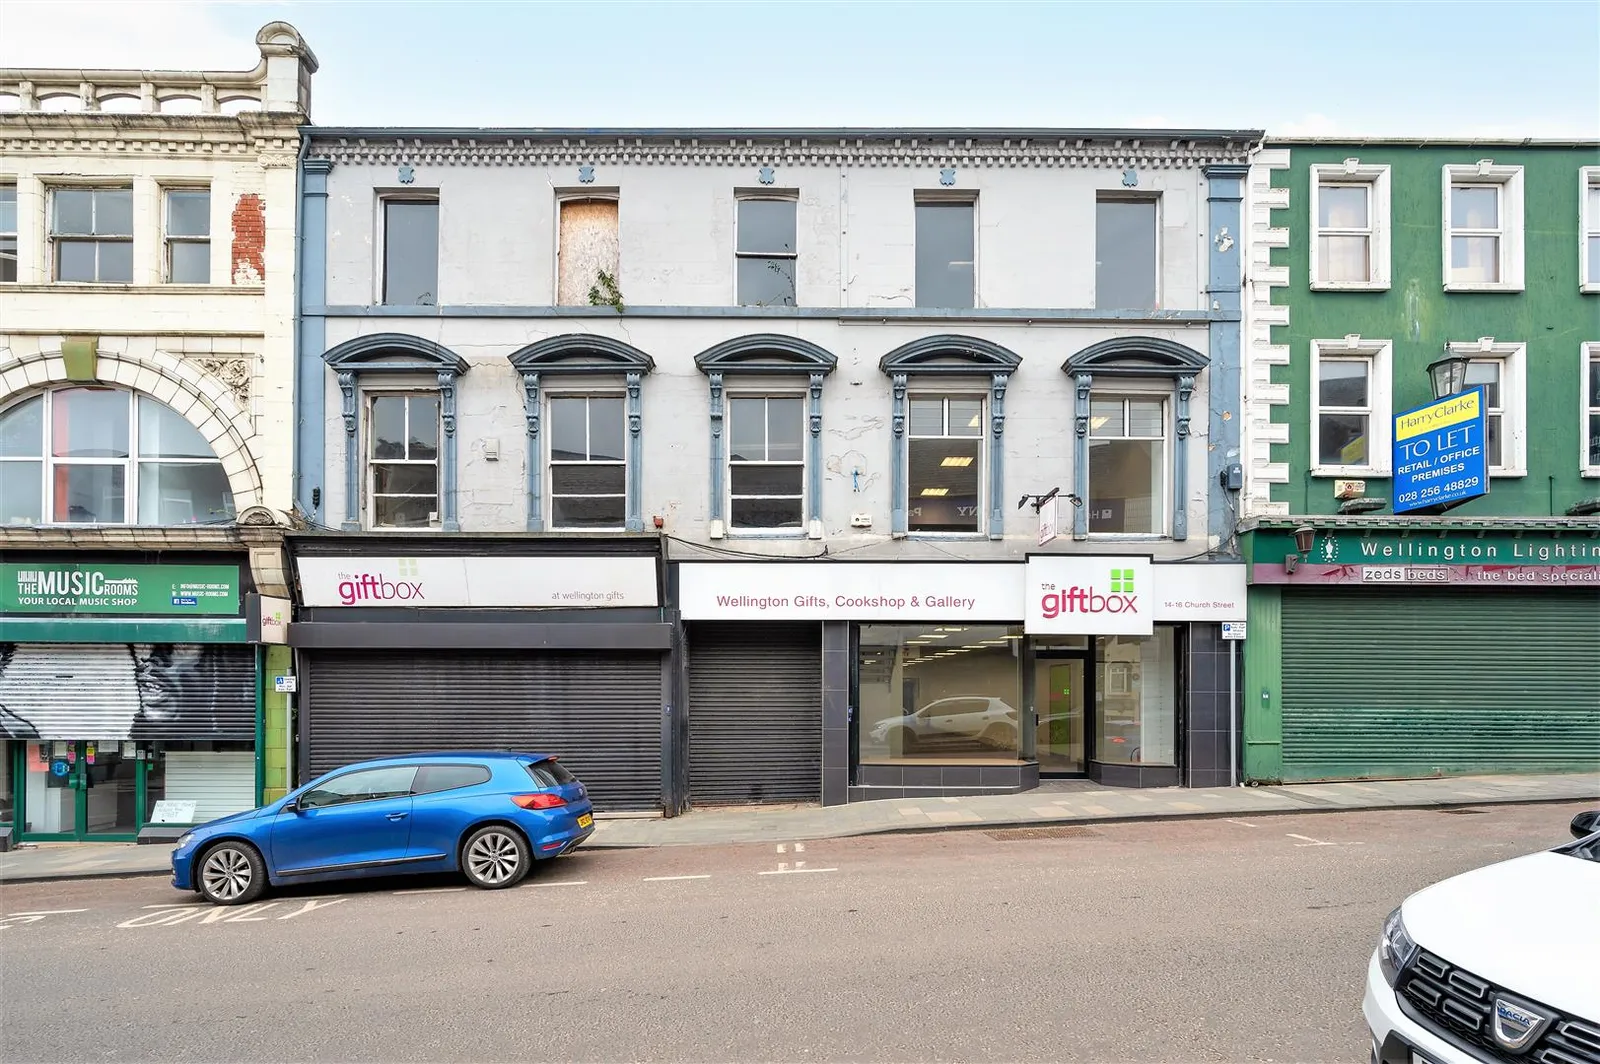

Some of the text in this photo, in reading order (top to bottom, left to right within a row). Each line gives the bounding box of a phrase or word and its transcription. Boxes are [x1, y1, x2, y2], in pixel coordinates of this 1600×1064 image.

[1400, 440, 1431, 460] TO
[1438, 424, 1476, 451] LET
[1398, 460, 1431, 475] RETAIL
[1440, 446, 1480, 464] OFFICE
[1411, 462, 1465, 483] PREMISES
[1398, 476, 1479, 503] 028 256 48829
[1409, 490, 1467, 507] www.harryclarke.co.uk
[1361, 543, 1498, 560] Wellington
[338, 572, 351, 580] the
[1365, 567, 1402, 580] zeds
[1407, 567, 1446, 581] beds
[1477, 571, 1501, 581] the
[1507, 571, 1535, 581] bed
[18, 571, 138, 596] THE MUSIC ROOMS
[338, 573, 425, 605] giftbox
[18, 598, 138, 606] YOUR LOCAL MUSIC SHOP
[551, 591, 625, 601] at wellington gifts
[716, 595, 975, 609] Wellington Gifts, Cookshop & Gallery
[1041, 586, 1138, 619] giftbox
[1164, 601, 1235, 609] 14-16 Church Street
[1497, 1006, 1531, 1026] DACIA
